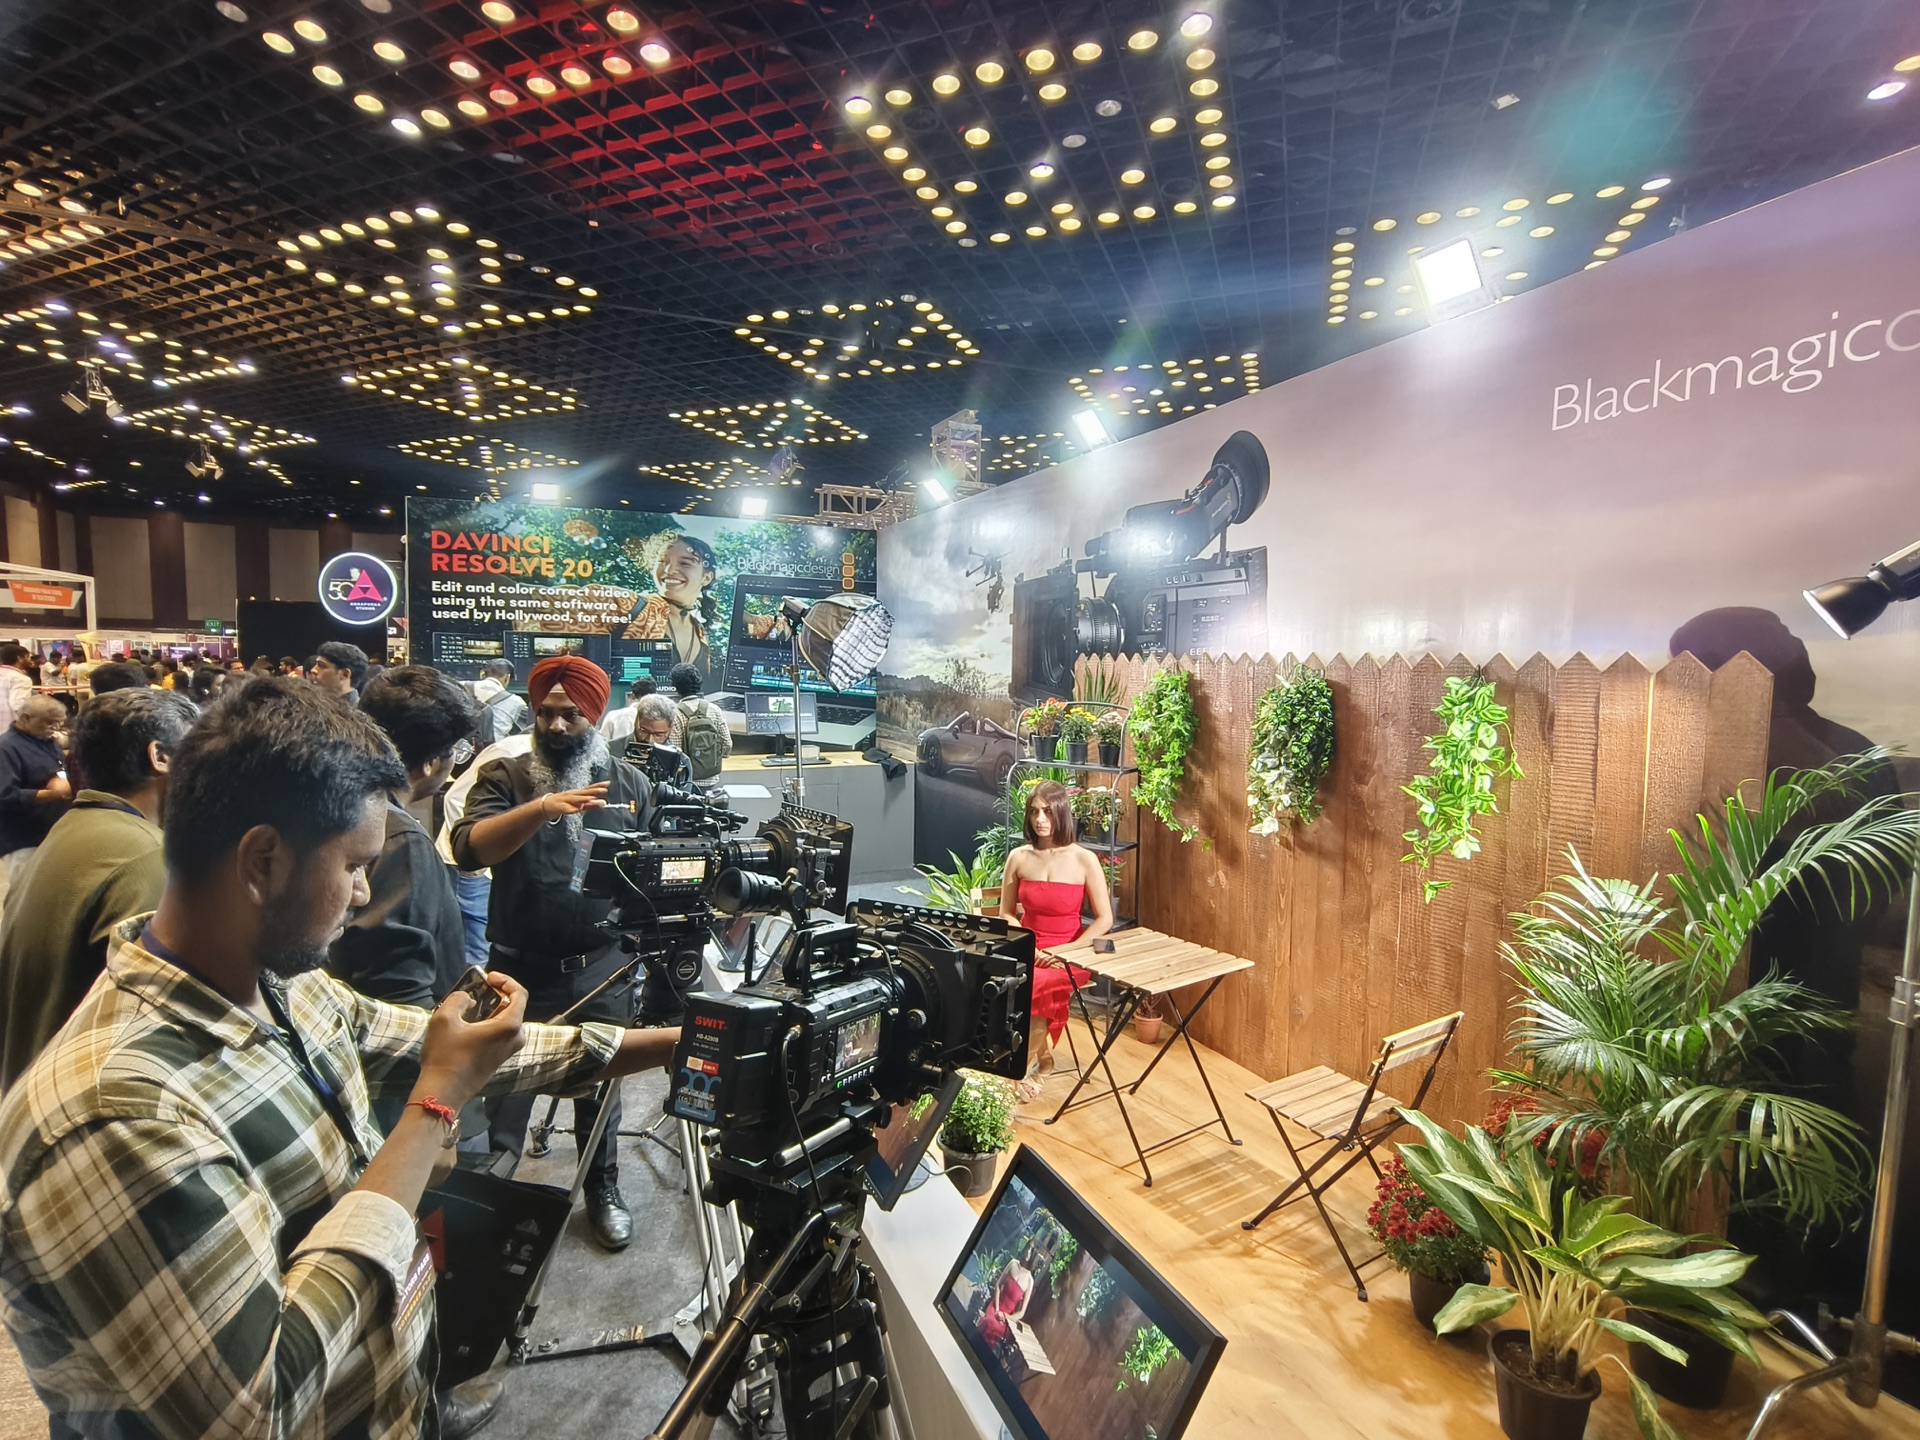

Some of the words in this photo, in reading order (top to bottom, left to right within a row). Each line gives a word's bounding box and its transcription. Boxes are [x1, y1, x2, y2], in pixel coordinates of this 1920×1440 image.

[431, 530, 551, 554] DAVINCI
[431, 552, 555, 576] RESOLVE
[562, 559, 593, 578] 20
[737, 557, 840, 580] Blackmagicdesign
[431, 580, 462, 592] Edit
[465, 582, 495, 594] and
[498, 583, 536, 595] color
[539, 586, 590, 597] correct
[592, 587, 630, 599] video
[432, 595, 476, 609] using
[480, 595, 505, 607] the
[509, 599, 550, 609] same
[554, 598, 618, 611] software
[432, 608, 469, 620] used
[473, 609, 491, 622] by
[495, 610, 573, 624] Hollywood,
[577, 612, 598, 623] for
[601, 612, 632, 624] free!
[695, 1016, 725, 1030] SWIT
[416, 1252, 430, 1276] PASS
